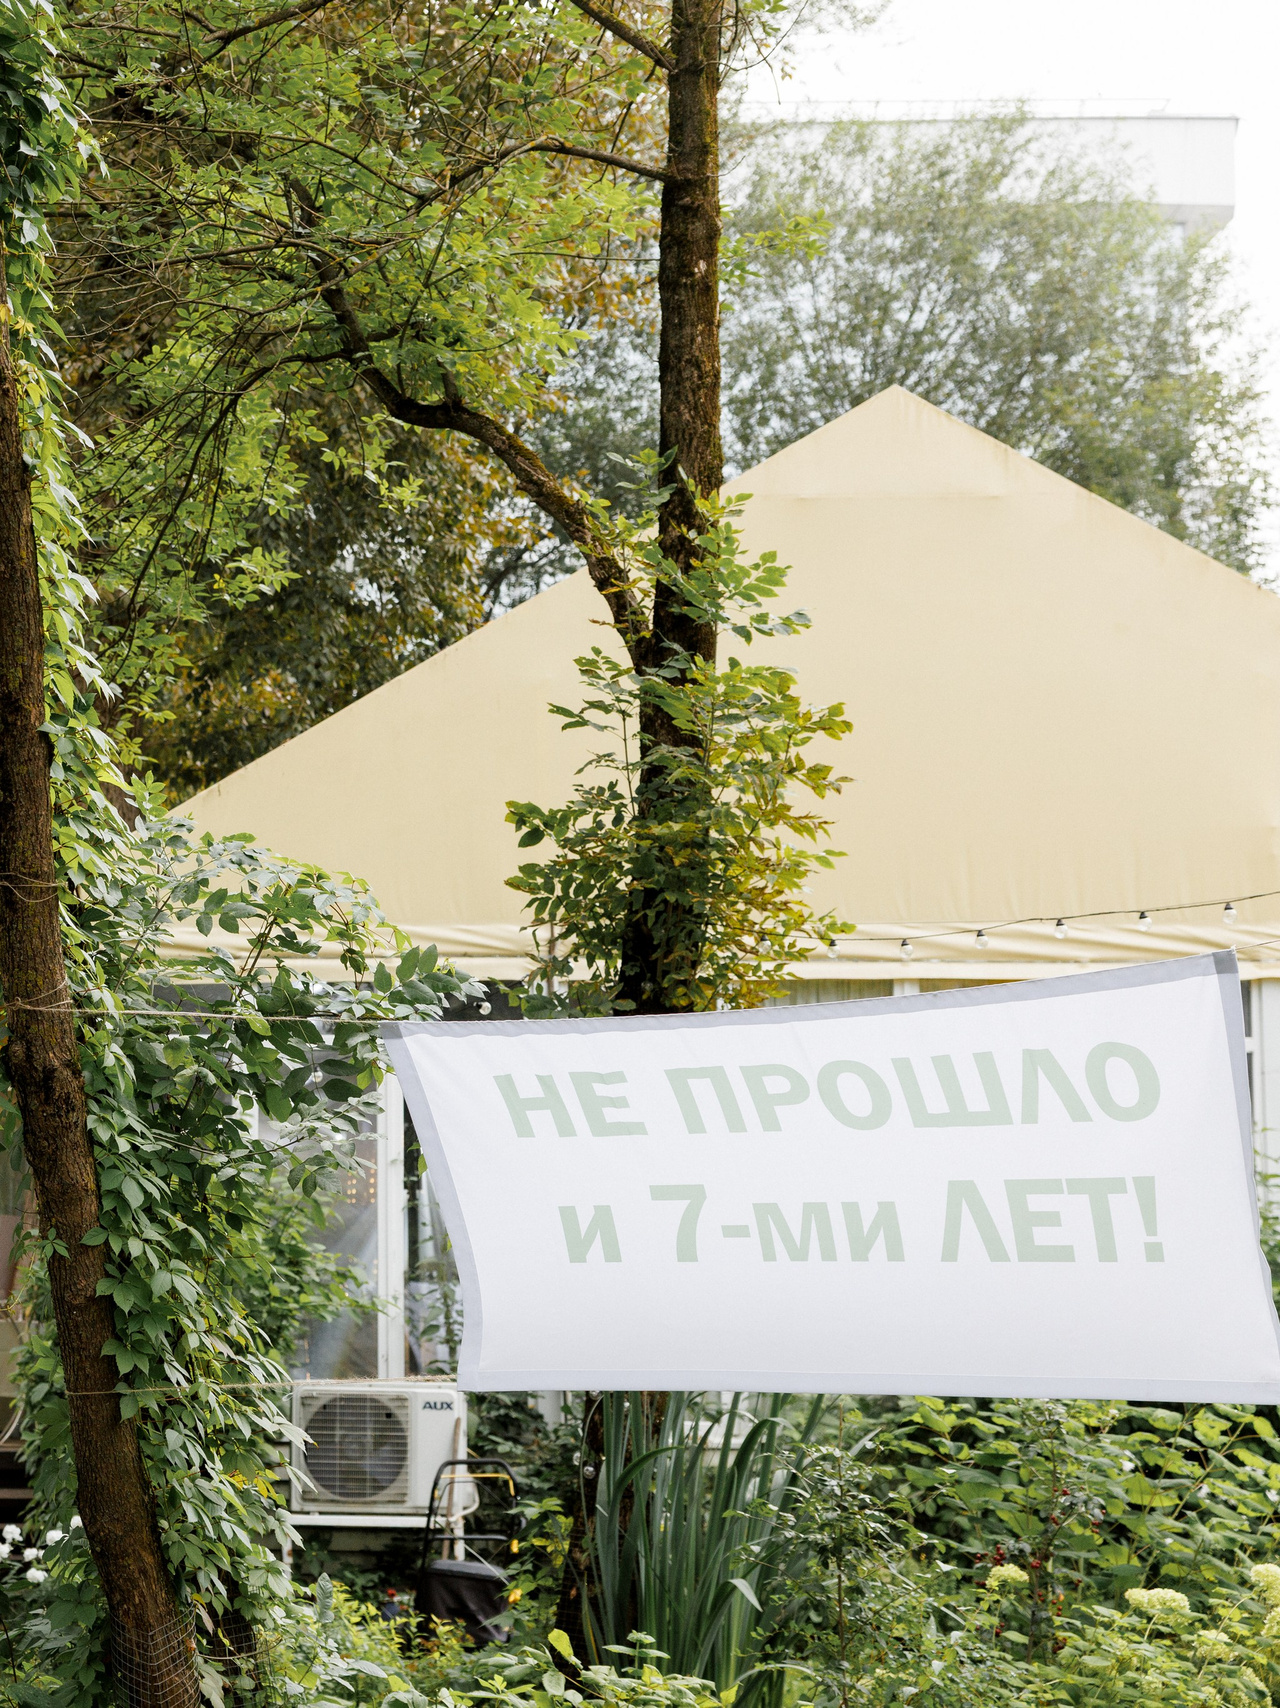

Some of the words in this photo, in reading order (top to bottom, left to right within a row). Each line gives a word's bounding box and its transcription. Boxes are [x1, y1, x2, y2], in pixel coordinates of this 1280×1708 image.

[494, 1066, 648, 1138] НЕ
[664, 1041, 1161, 1135] ПРОШЛО
[557, 1204, 622, 1264] и
[649, 1184, 904, 1263] 7-ми
[941, 1176, 1164, 1263] ЛЕТ!
[422, 1401, 453, 1411] AUX
